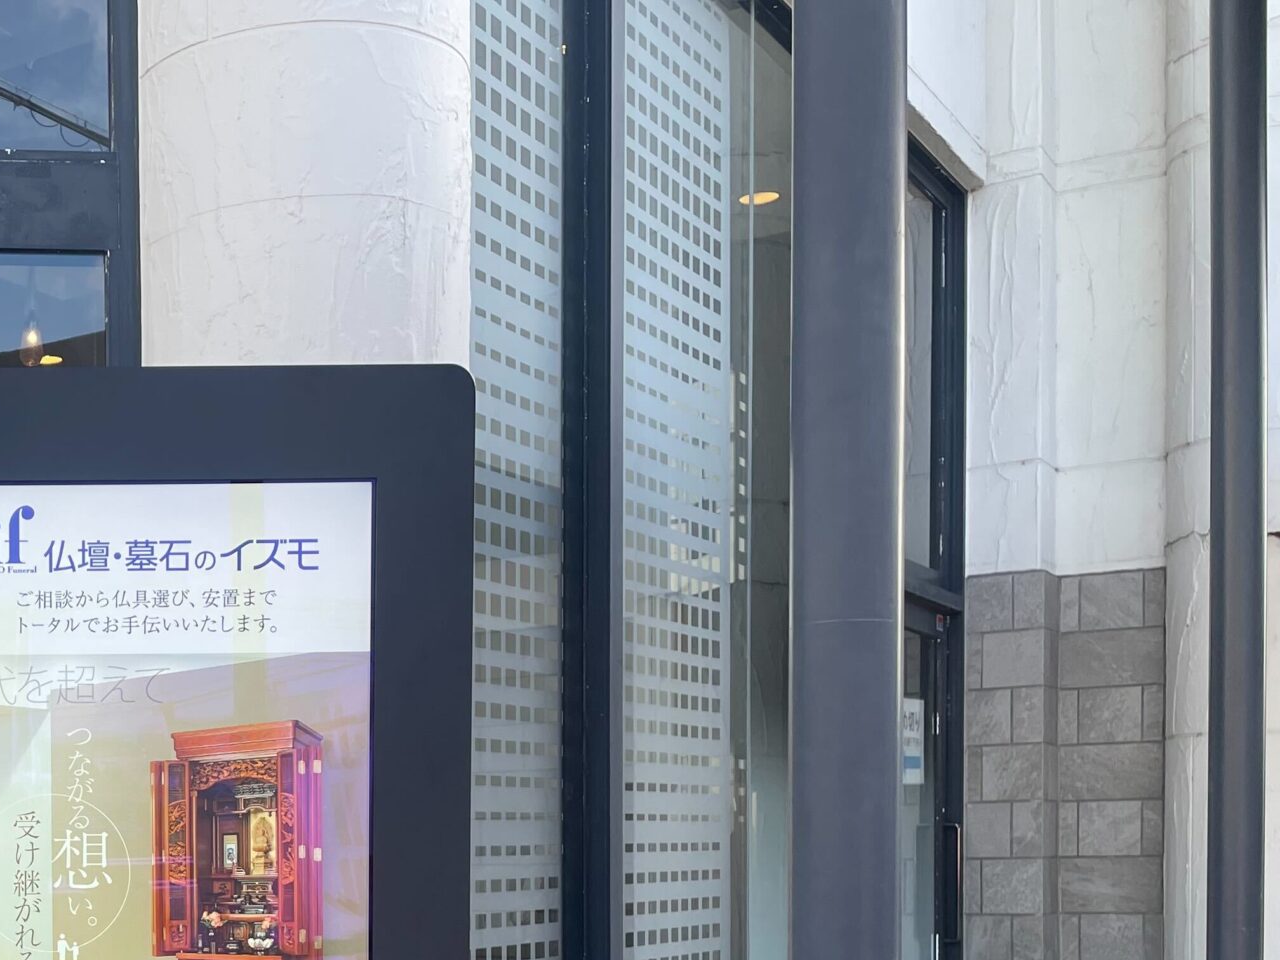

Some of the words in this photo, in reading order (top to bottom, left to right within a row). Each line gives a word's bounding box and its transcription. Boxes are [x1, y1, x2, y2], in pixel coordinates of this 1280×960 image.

[44, 538, 320, 573] 仏壇・墓石のイズモ
[8, 566, 38, 574] Funeral
[16, 588, 277, 609] ご相談から仏具選び、安置まで
[17, 615, 279, 635] トータルでお手伝いいたします。
